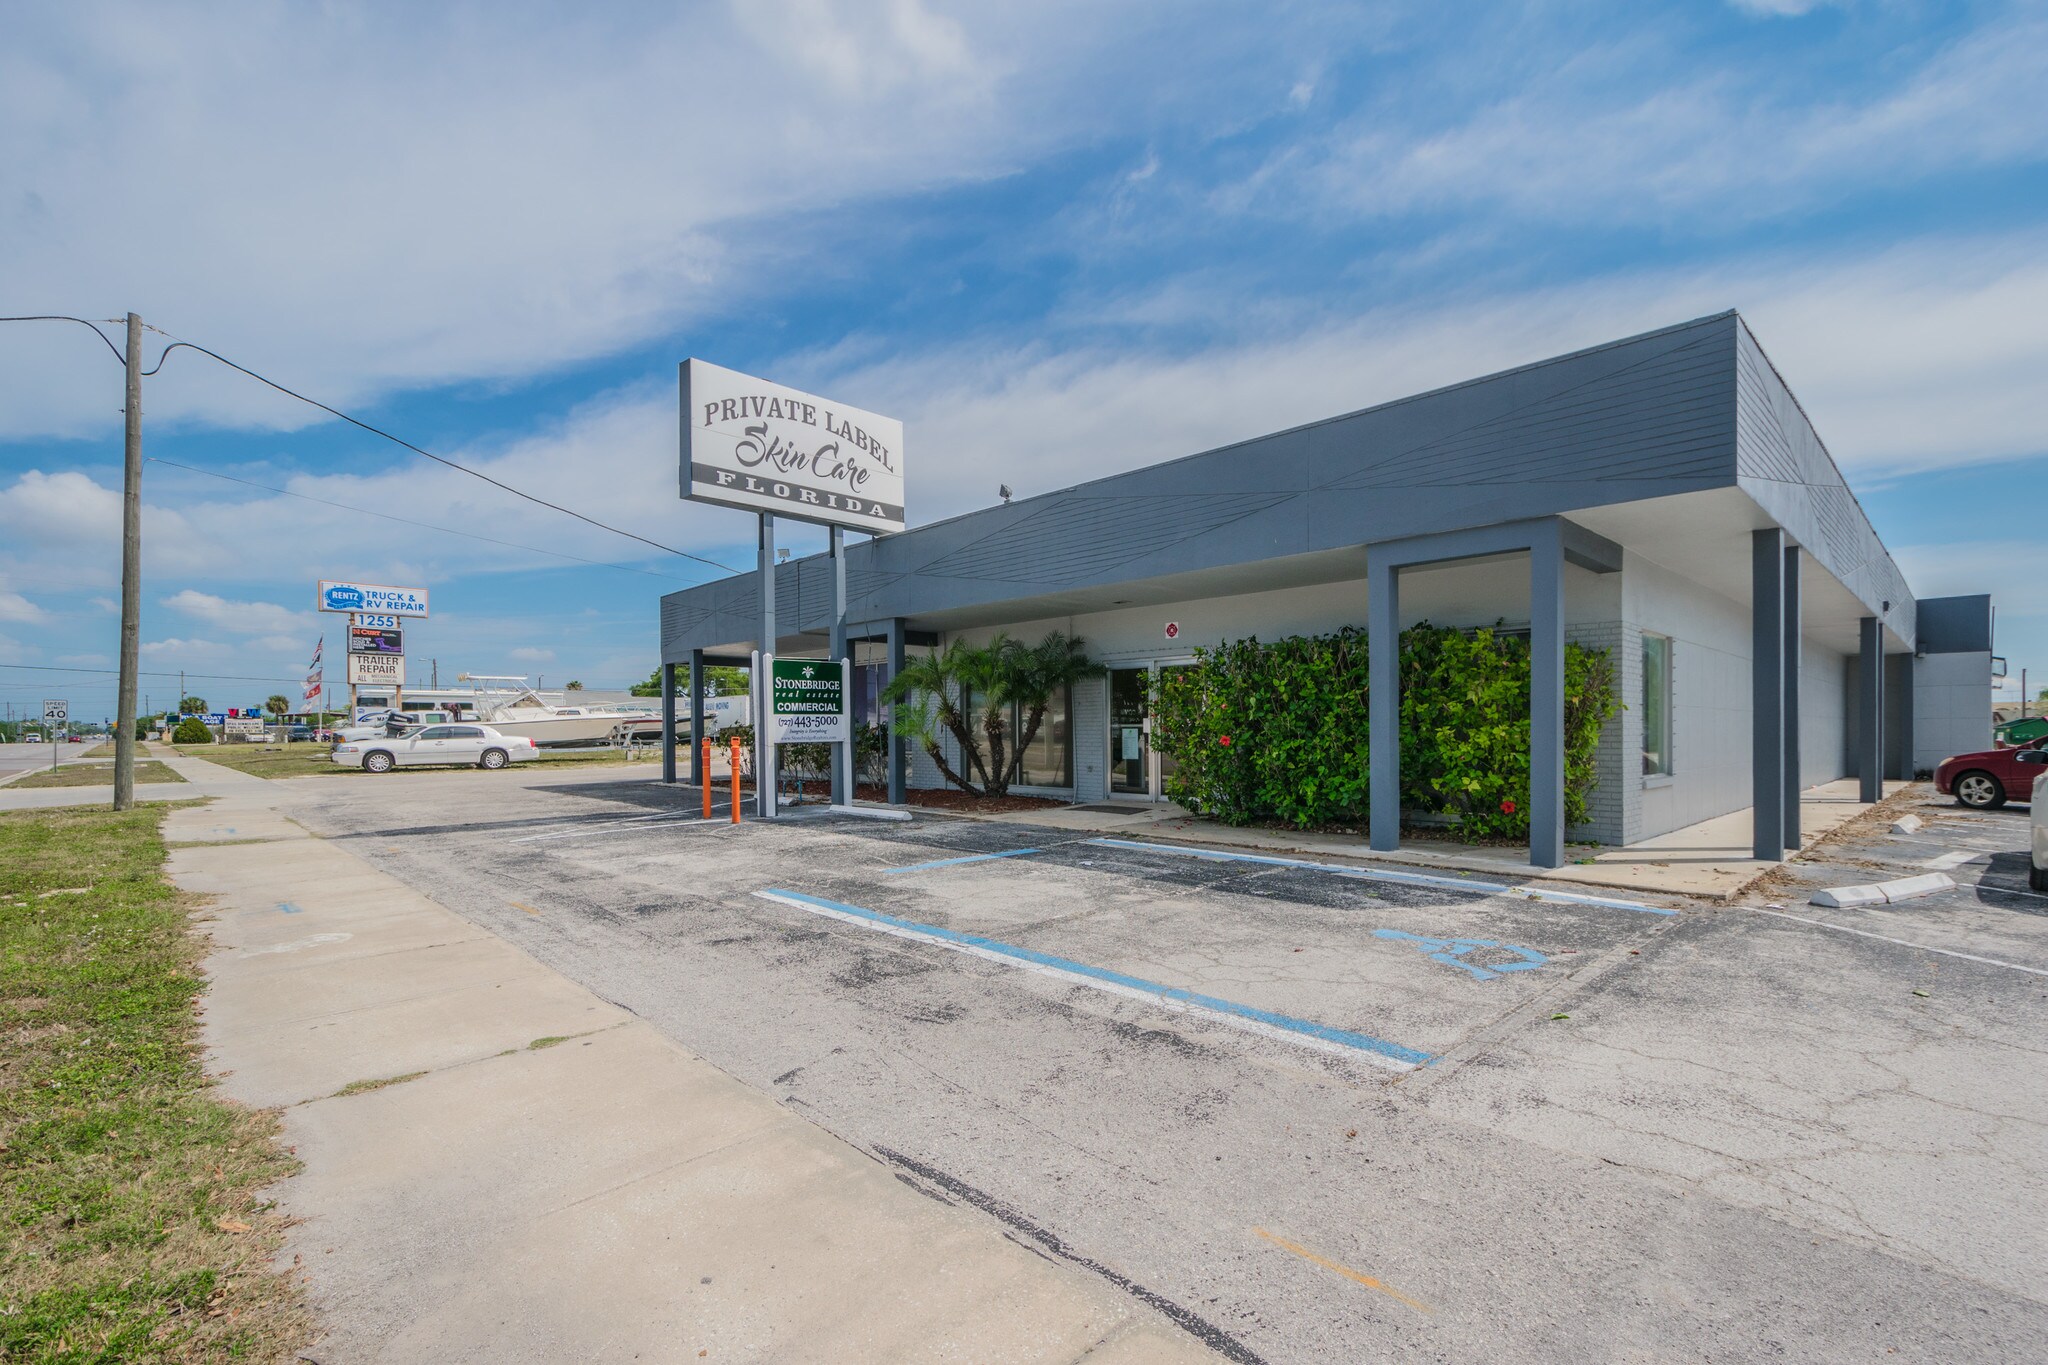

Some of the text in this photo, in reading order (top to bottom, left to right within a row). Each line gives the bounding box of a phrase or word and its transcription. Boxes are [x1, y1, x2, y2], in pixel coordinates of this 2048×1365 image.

[704, 396, 894, 474] PRIVATE LABEL
[735, 421, 870, 493] Skin Care
[716, 470, 886, 517] FLORIDA
[331, 590, 359, 601] RENTZ
[365, 590, 416, 603] TRUCK &
[366, 600, 382, 609] RV
[386, 601, 425, 612] REPAIR
[358, 614, 394, 628] 1255
[355, 655, 399, 666] TRAILER
[359, 664, 396, 674] REPAIR
[357, 674, 367, 682] ALL
[775, 676, 840, 690] STONEBRIDGE
[775, 690, 800, 698] real
[777, 702, 839, 711] COMMERCIAL
[45, 710, 66, 718] 40
[227, 708, 261, 718] VFW
[778, 716, 838, 728] (727) 443-5000
